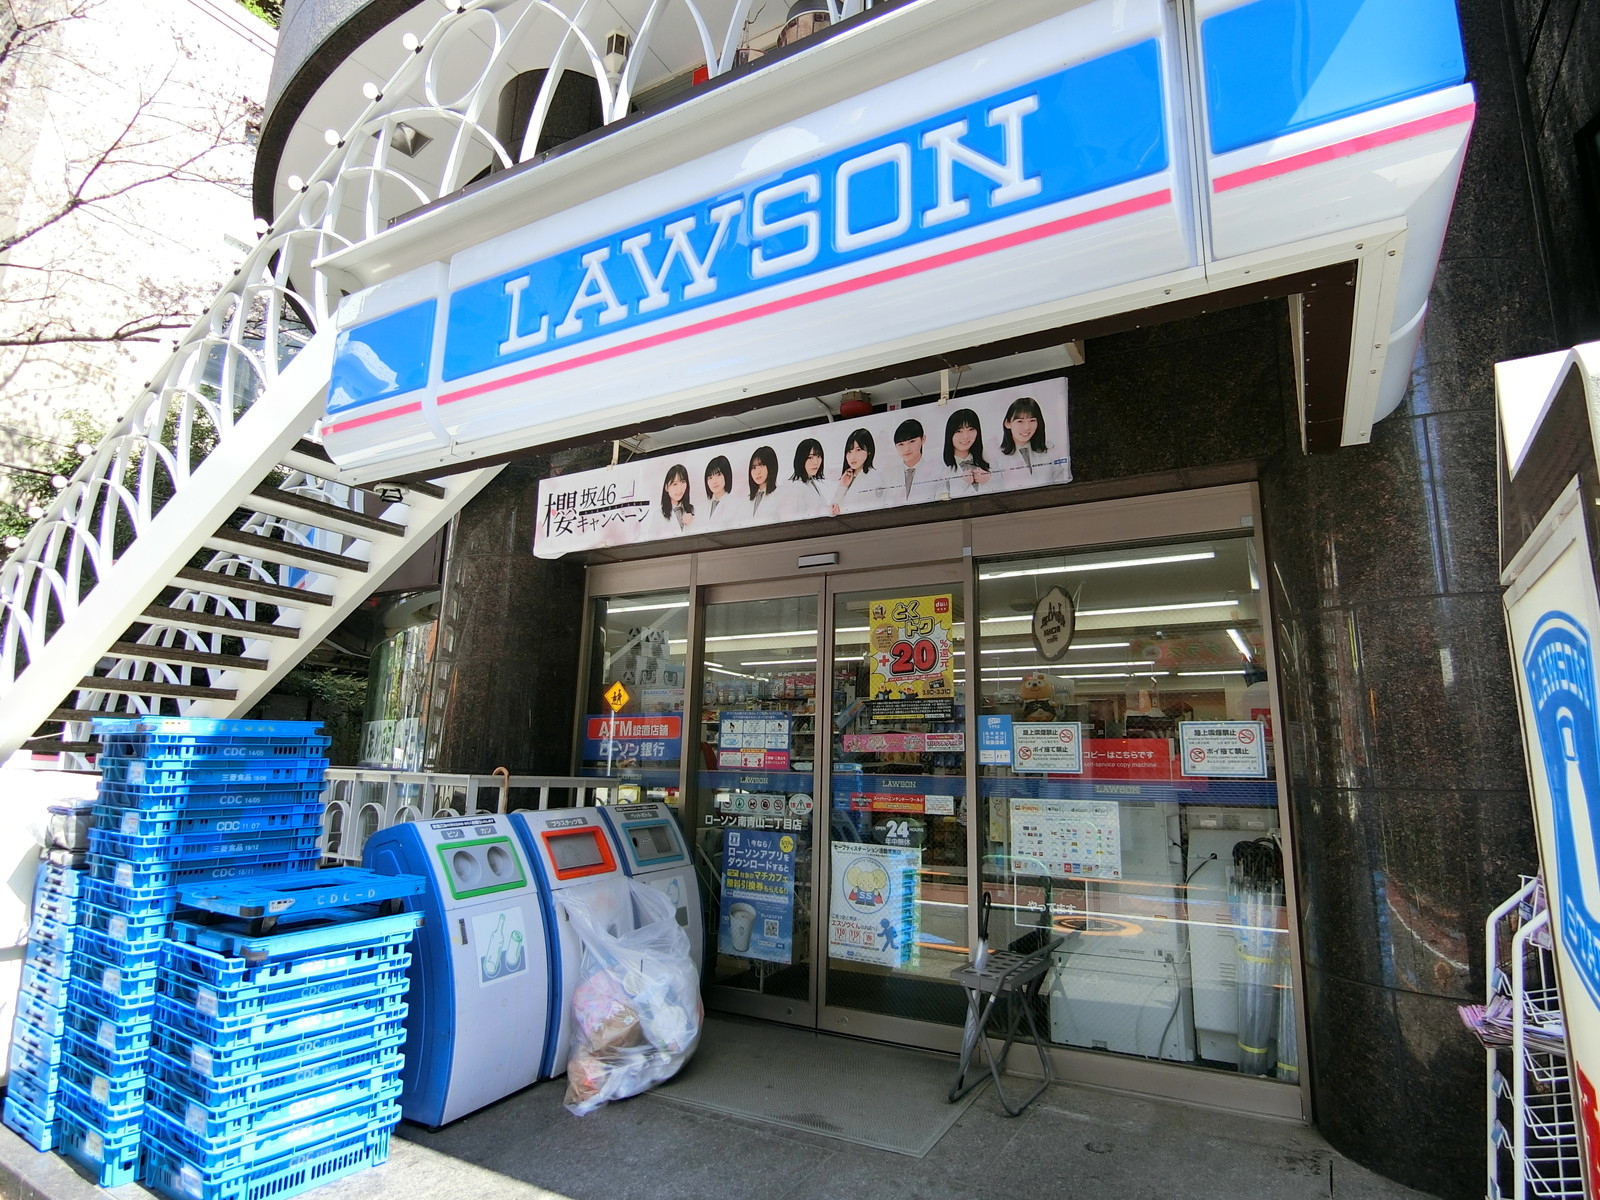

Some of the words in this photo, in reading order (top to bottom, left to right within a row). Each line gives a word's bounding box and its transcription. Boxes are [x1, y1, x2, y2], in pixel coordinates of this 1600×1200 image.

[498, 94, 1042, 357] LAWSON
[576, 507, 650, 533] キャンペーン
[891, 600, 920, 622] とく
[905, 616, 935, 639] トク
[1530, 641, 1591, 712] LAWSON
[598, 720, 669, 737] ATM設置店舗
[1194, 729, 1236, 737] 路上喫煙禁止
[223, 747, 246, 757] CDC
[599, 741, 666, 757] ローソン銀行
[221, 773, 252, 782] 三菱食品
[740, 776, 769, 784] LAWSON
[882, 780, 916, 788] LAWSON
[1095, 785, 1141, 794] LAWSON
[219, 795, 243, 805] CDC
[245, 796, 261, 804] 14/05
[216, 820, 240, 831] CDC
[705, 814, 803, 831] ローソン南青山二丁目店
[886, 820, 909, 838] 24
[480, 827, 492, 835] カン
[212, 843, 244, 853] 三菱食品
[885, 838, 911, 846] 年中無休
[728, 847, 790, 862] ローソンアプリを
[727, 857, 789, 873] ダウンロードすると
[212, 867, 236, 878] CDC
[859, 891, 873, 900] SS
[1027, 900, 1077, 916] やってます
[301, 984, 326, 997] CDC
[296, 1040, 321, 1054] CDC
[295, 1067, 321, 1082] CDC
[289, 1151, 314, 1168] CDC
